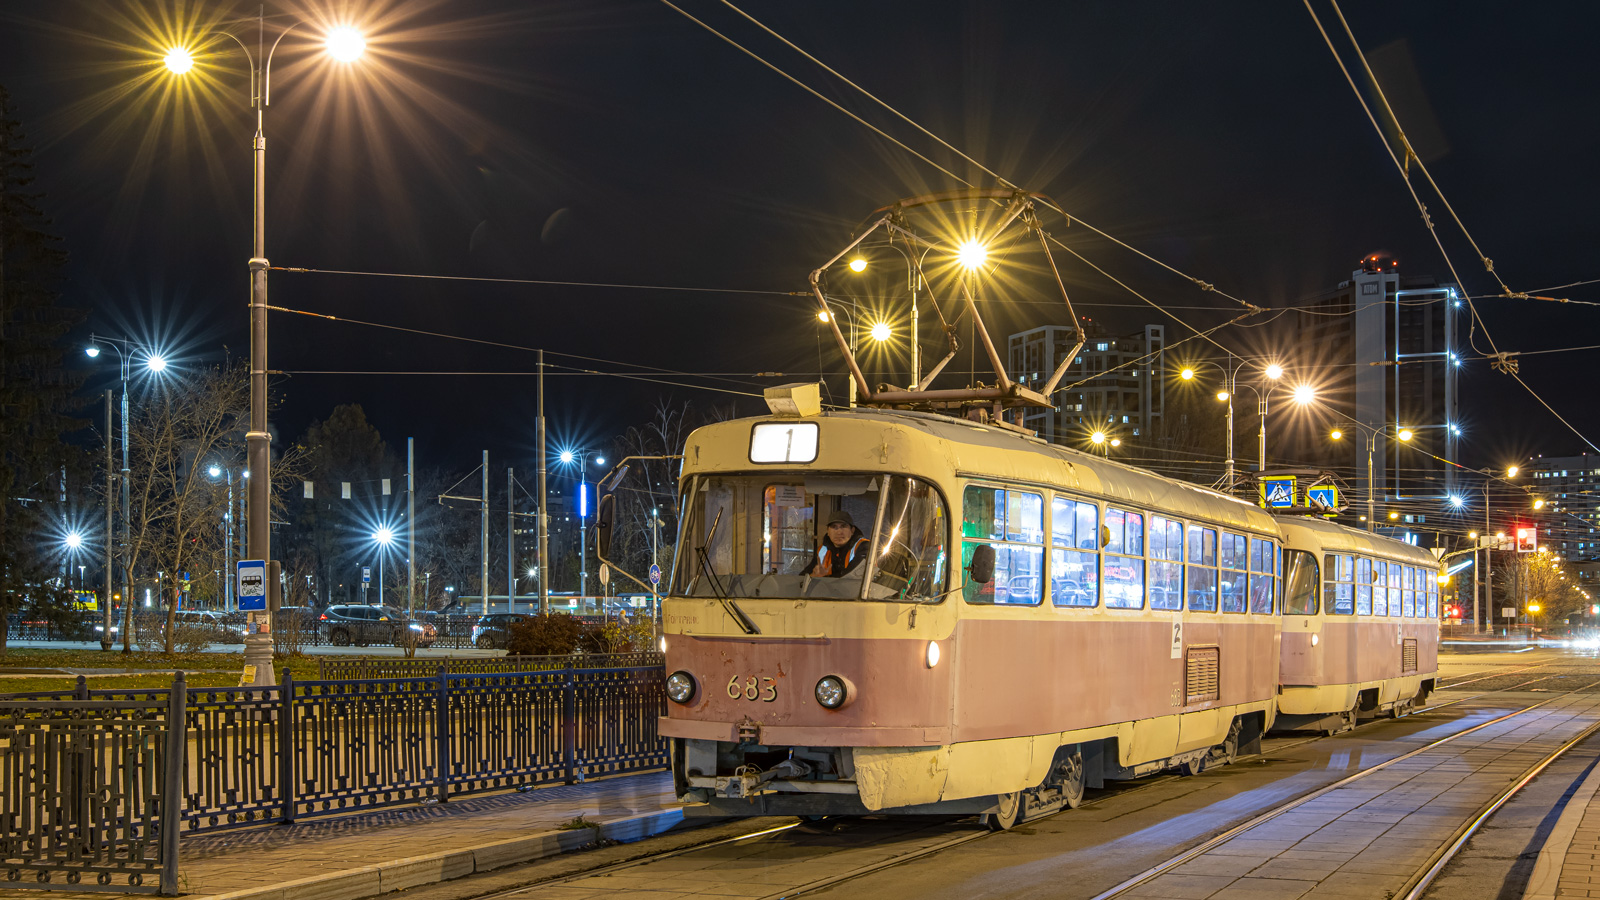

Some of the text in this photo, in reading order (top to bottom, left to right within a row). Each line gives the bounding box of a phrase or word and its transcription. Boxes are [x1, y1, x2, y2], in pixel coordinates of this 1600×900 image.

[786, 428, 794, 462] 1
[1173, 622, 1181, 644] 2
[726, 675, 778, 702] 683
